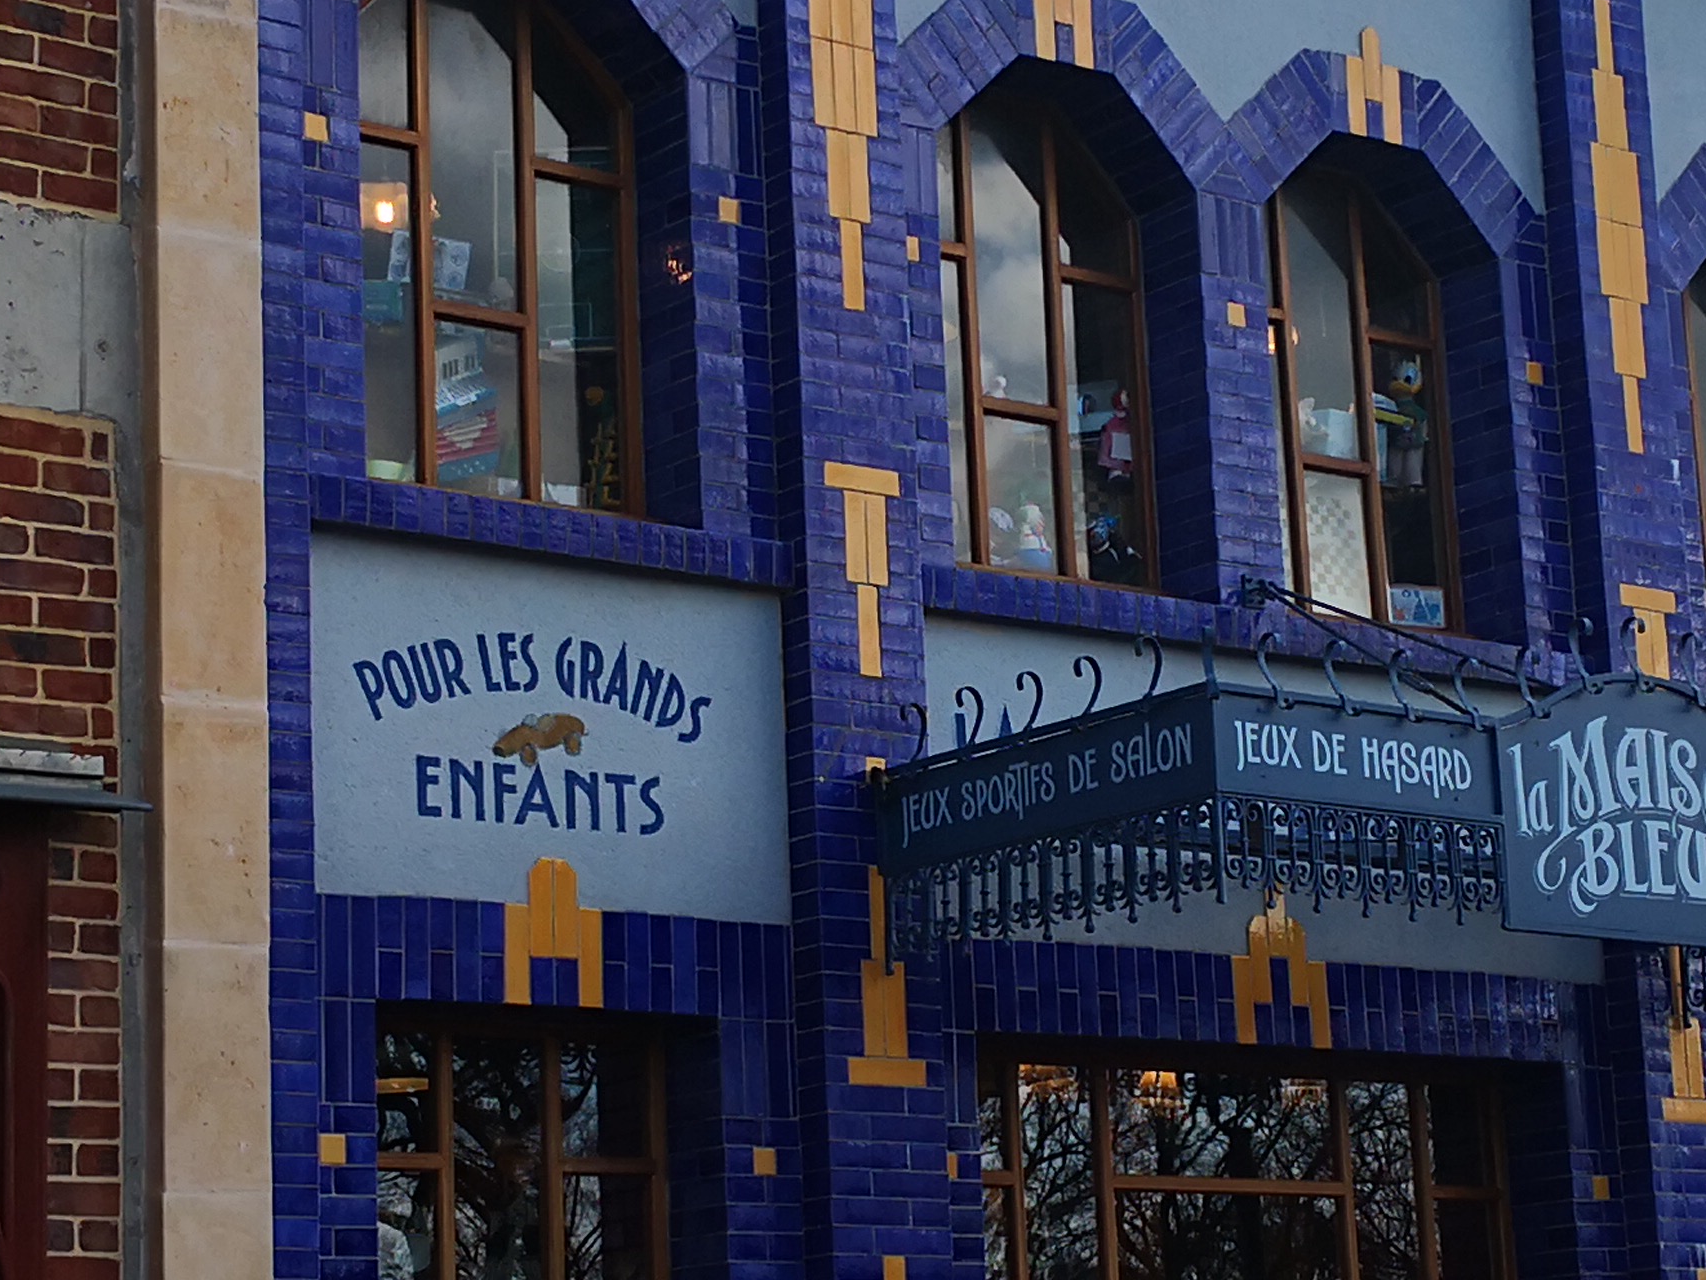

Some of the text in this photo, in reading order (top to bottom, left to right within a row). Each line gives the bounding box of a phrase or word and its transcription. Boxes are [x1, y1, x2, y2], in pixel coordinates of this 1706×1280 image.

[353, 632, 712, 743] POUR LES GRANDS
[415, 755, 665, 835] ENFANTS
[900, 722, 1193, 848] JEUX SPORTIFS DE SALON
[1234, 720, 1472, 799] JEUX DE HASARD
